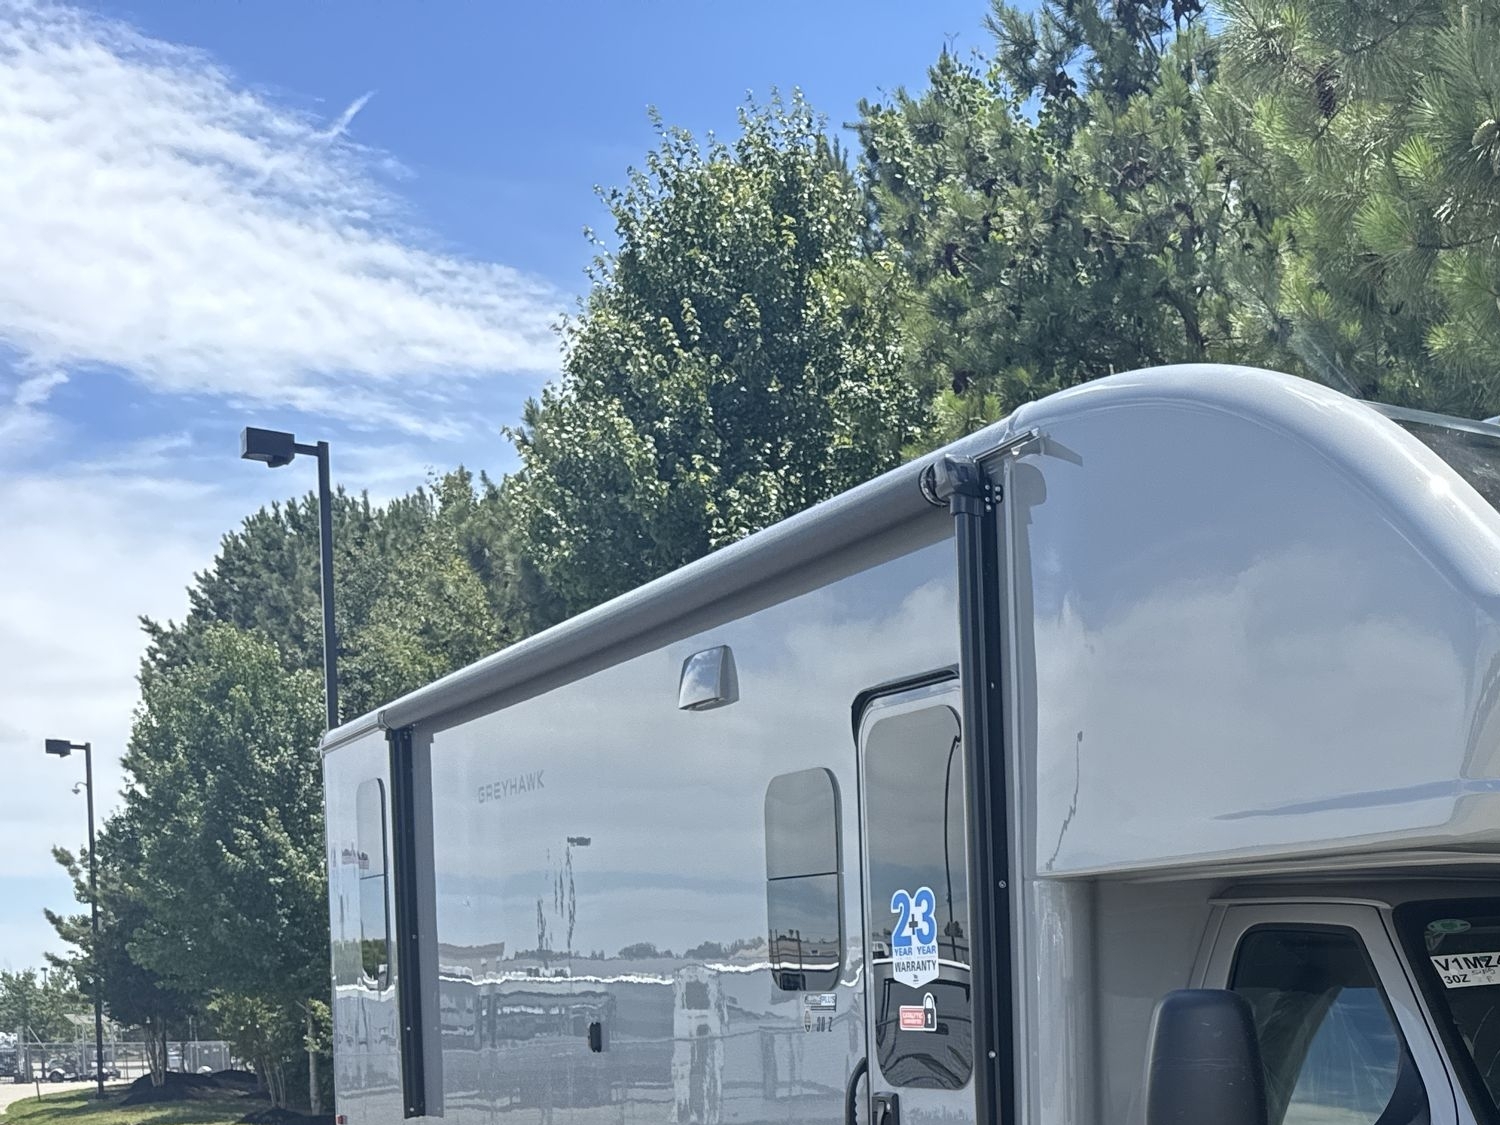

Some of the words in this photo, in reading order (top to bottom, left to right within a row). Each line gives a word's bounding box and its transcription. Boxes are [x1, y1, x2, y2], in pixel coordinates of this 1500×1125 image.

[478, 769, 545, 804] GREYHAWK
[894, 947, 913, 957] YEAR
[916, 945, 937, 955] YEAR
[894, 960, 937, 973] WARRANTY
[1443, 974, 1471, 985] 30Z
